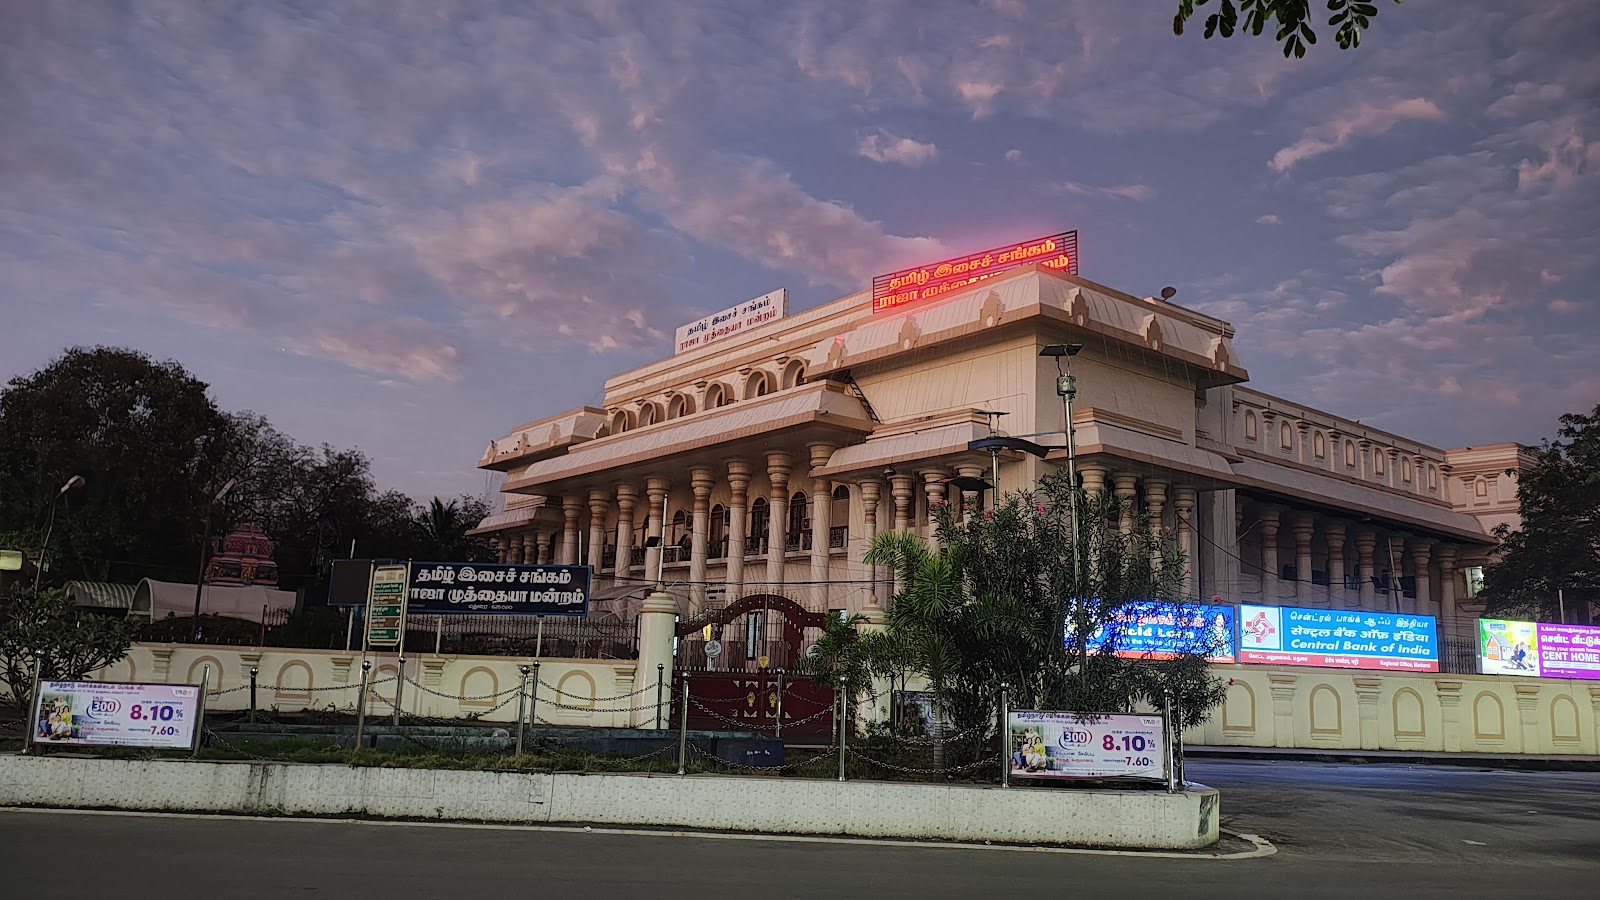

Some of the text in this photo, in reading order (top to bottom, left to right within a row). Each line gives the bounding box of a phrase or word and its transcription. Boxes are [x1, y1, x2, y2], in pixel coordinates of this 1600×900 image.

[889, 239, 1056, 290] தமிழ் இசைச் சங்கம்
[879, 290, 919, 308] ராஜா
[687, 295, 771, 337] தமிழ் இசைச் சங்கம்
[703, 321, 742, 343] முத்தையா
[746, 306, 778, 326] மன்றம்
[415, 566, 572, 584] தமிழ் இசைச் சங்கம்
[409, 586, 585, 605] ாஜா முத்தையா மன்றம்
[1289, 610, 1331, 623] சென்ட்ரல்
[1336, 613, 1361, 624] பாங்க்
[1395, 617, 1429, 630] இந்தியா
[1290, 626, 1331, 638] सेन्ट्रल
[1333, 626, 1357, 638] बैंक
[1392, 629, 1430, 643] इंडिया
[1290, 638, 1431, 656] Central Bank of India
[1380, 660, 1399, 668] Regional
[1542, 651, 1600, 662] CENT HOME
[93, 701, 115, 712] 300
[1064, 732, 1086, 743] 300
